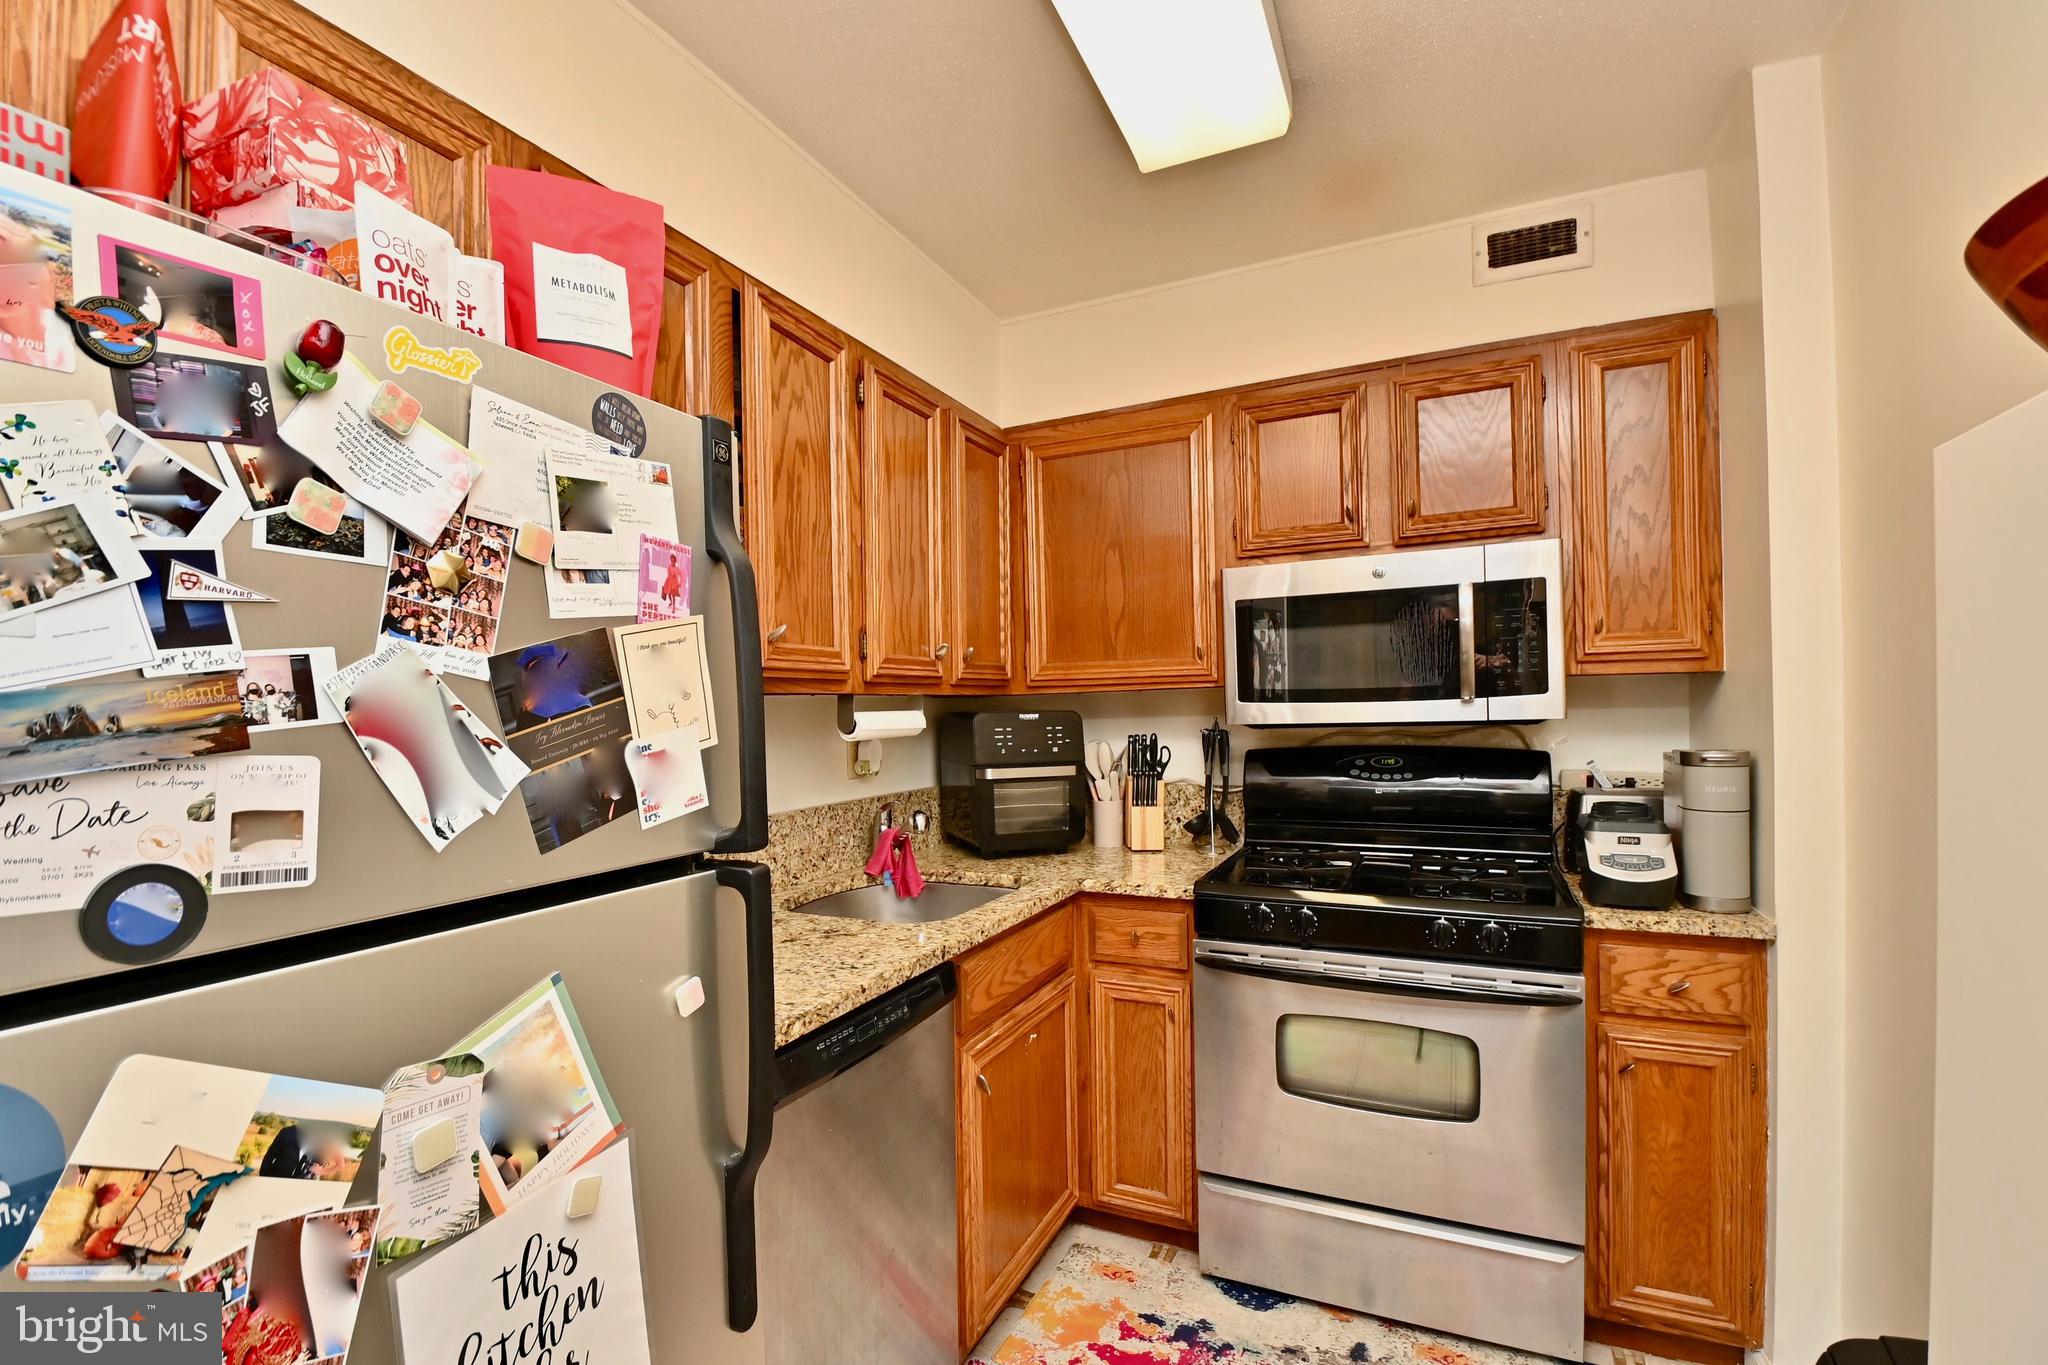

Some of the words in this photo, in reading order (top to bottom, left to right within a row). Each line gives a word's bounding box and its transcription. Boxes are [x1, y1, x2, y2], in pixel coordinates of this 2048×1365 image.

[375, 254, 429, 291] over
[551, 276, 616, 301] METABOLISM
[377, 280, 443, 322] night
[391, 332, 457, 367] Glossier
[296, 368, 326, 389] Holland
[344, 401, 364, 422] Wishing
[372, 419, 383, 429] Our
[610, 418, 624, 435] NEED
[35, 461, 94, 479] Beautiful
[204, 584, 253, 598] HARVARD
[642, 601, 659, 612] SHE
[145, 681, 226, 704] Iceland
[104, 762, 172, 772] ARDING
[176, 762, 207, 771] PASS
[246, 765, 273, 773] JOIN
[0, 813, 40, 840] the
[47, 797, 149, 840] Date
[3, 857, 43, 866] Wedding
[391, 1108, 415, 1125] COME
[418, 1101, 434, 1116] GET
[438, 1092, 465, 1109] AWAY!
[491, 1233, 580, 1311] this
